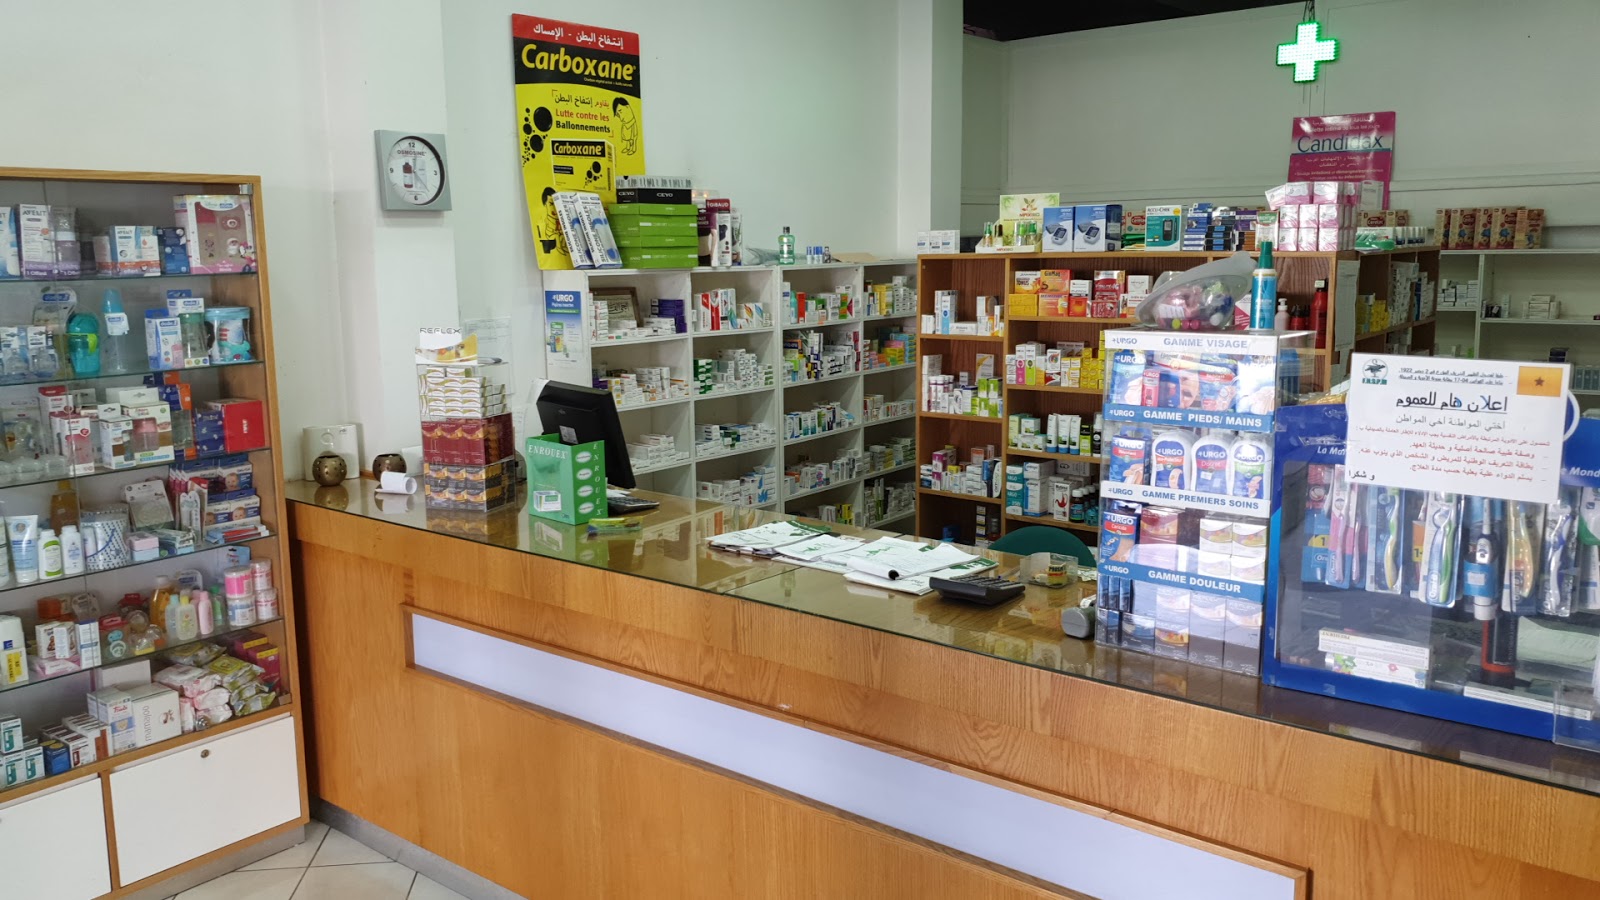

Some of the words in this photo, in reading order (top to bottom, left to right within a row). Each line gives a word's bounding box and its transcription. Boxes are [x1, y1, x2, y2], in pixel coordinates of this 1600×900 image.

[534, 24, 564, 40] الإمساك
[576, 31, 596, 44] البطن
[555, 95, 572, 106] البطن
[556, 109, 574, 118] Lutte
[576, 112, 598, 121] contre
[600, 114, 609, 122] les
[556, 121, 610, 133] Ballonnements
[554, 143, 602, 155] Carboxane
[1298, 134, 1384, 154] Candidax
[1163, 337, 1203, 347] GAMME
[1207, 340, 1248, 349] VISAGE
[1396, 392, 1436, 407] للعموم
[1440, 393, 1462, 410] هام
[1144, 410, 1182, 421] GAMME
[1226, 416, 1262, 427] MAINS
[1396, 414, 1426, 424] المواطن
[1429, 416, 1446, 427] أخي
[1449, 416, 1482, 428] المواطنة
[1119, 440, 1144, 449] URGO
[1317, 446, 1327, 454] La
[528, 445, 567, 459] ENROUEX
[1349, 470, 1367, 478] شكرا
[1142, 490, 1175, 500] GAMME
[1178, 494, 1226, 506] PREMIERS
[1229, 500, 1258, 510] SOINS
[1110, 515, 1134, 524] URGO
[1108, 565, 1128, 574] URGO
[1148, 570, 1186, 584] GAMME
[1189, 577, 1241, 593] DOULEUR
